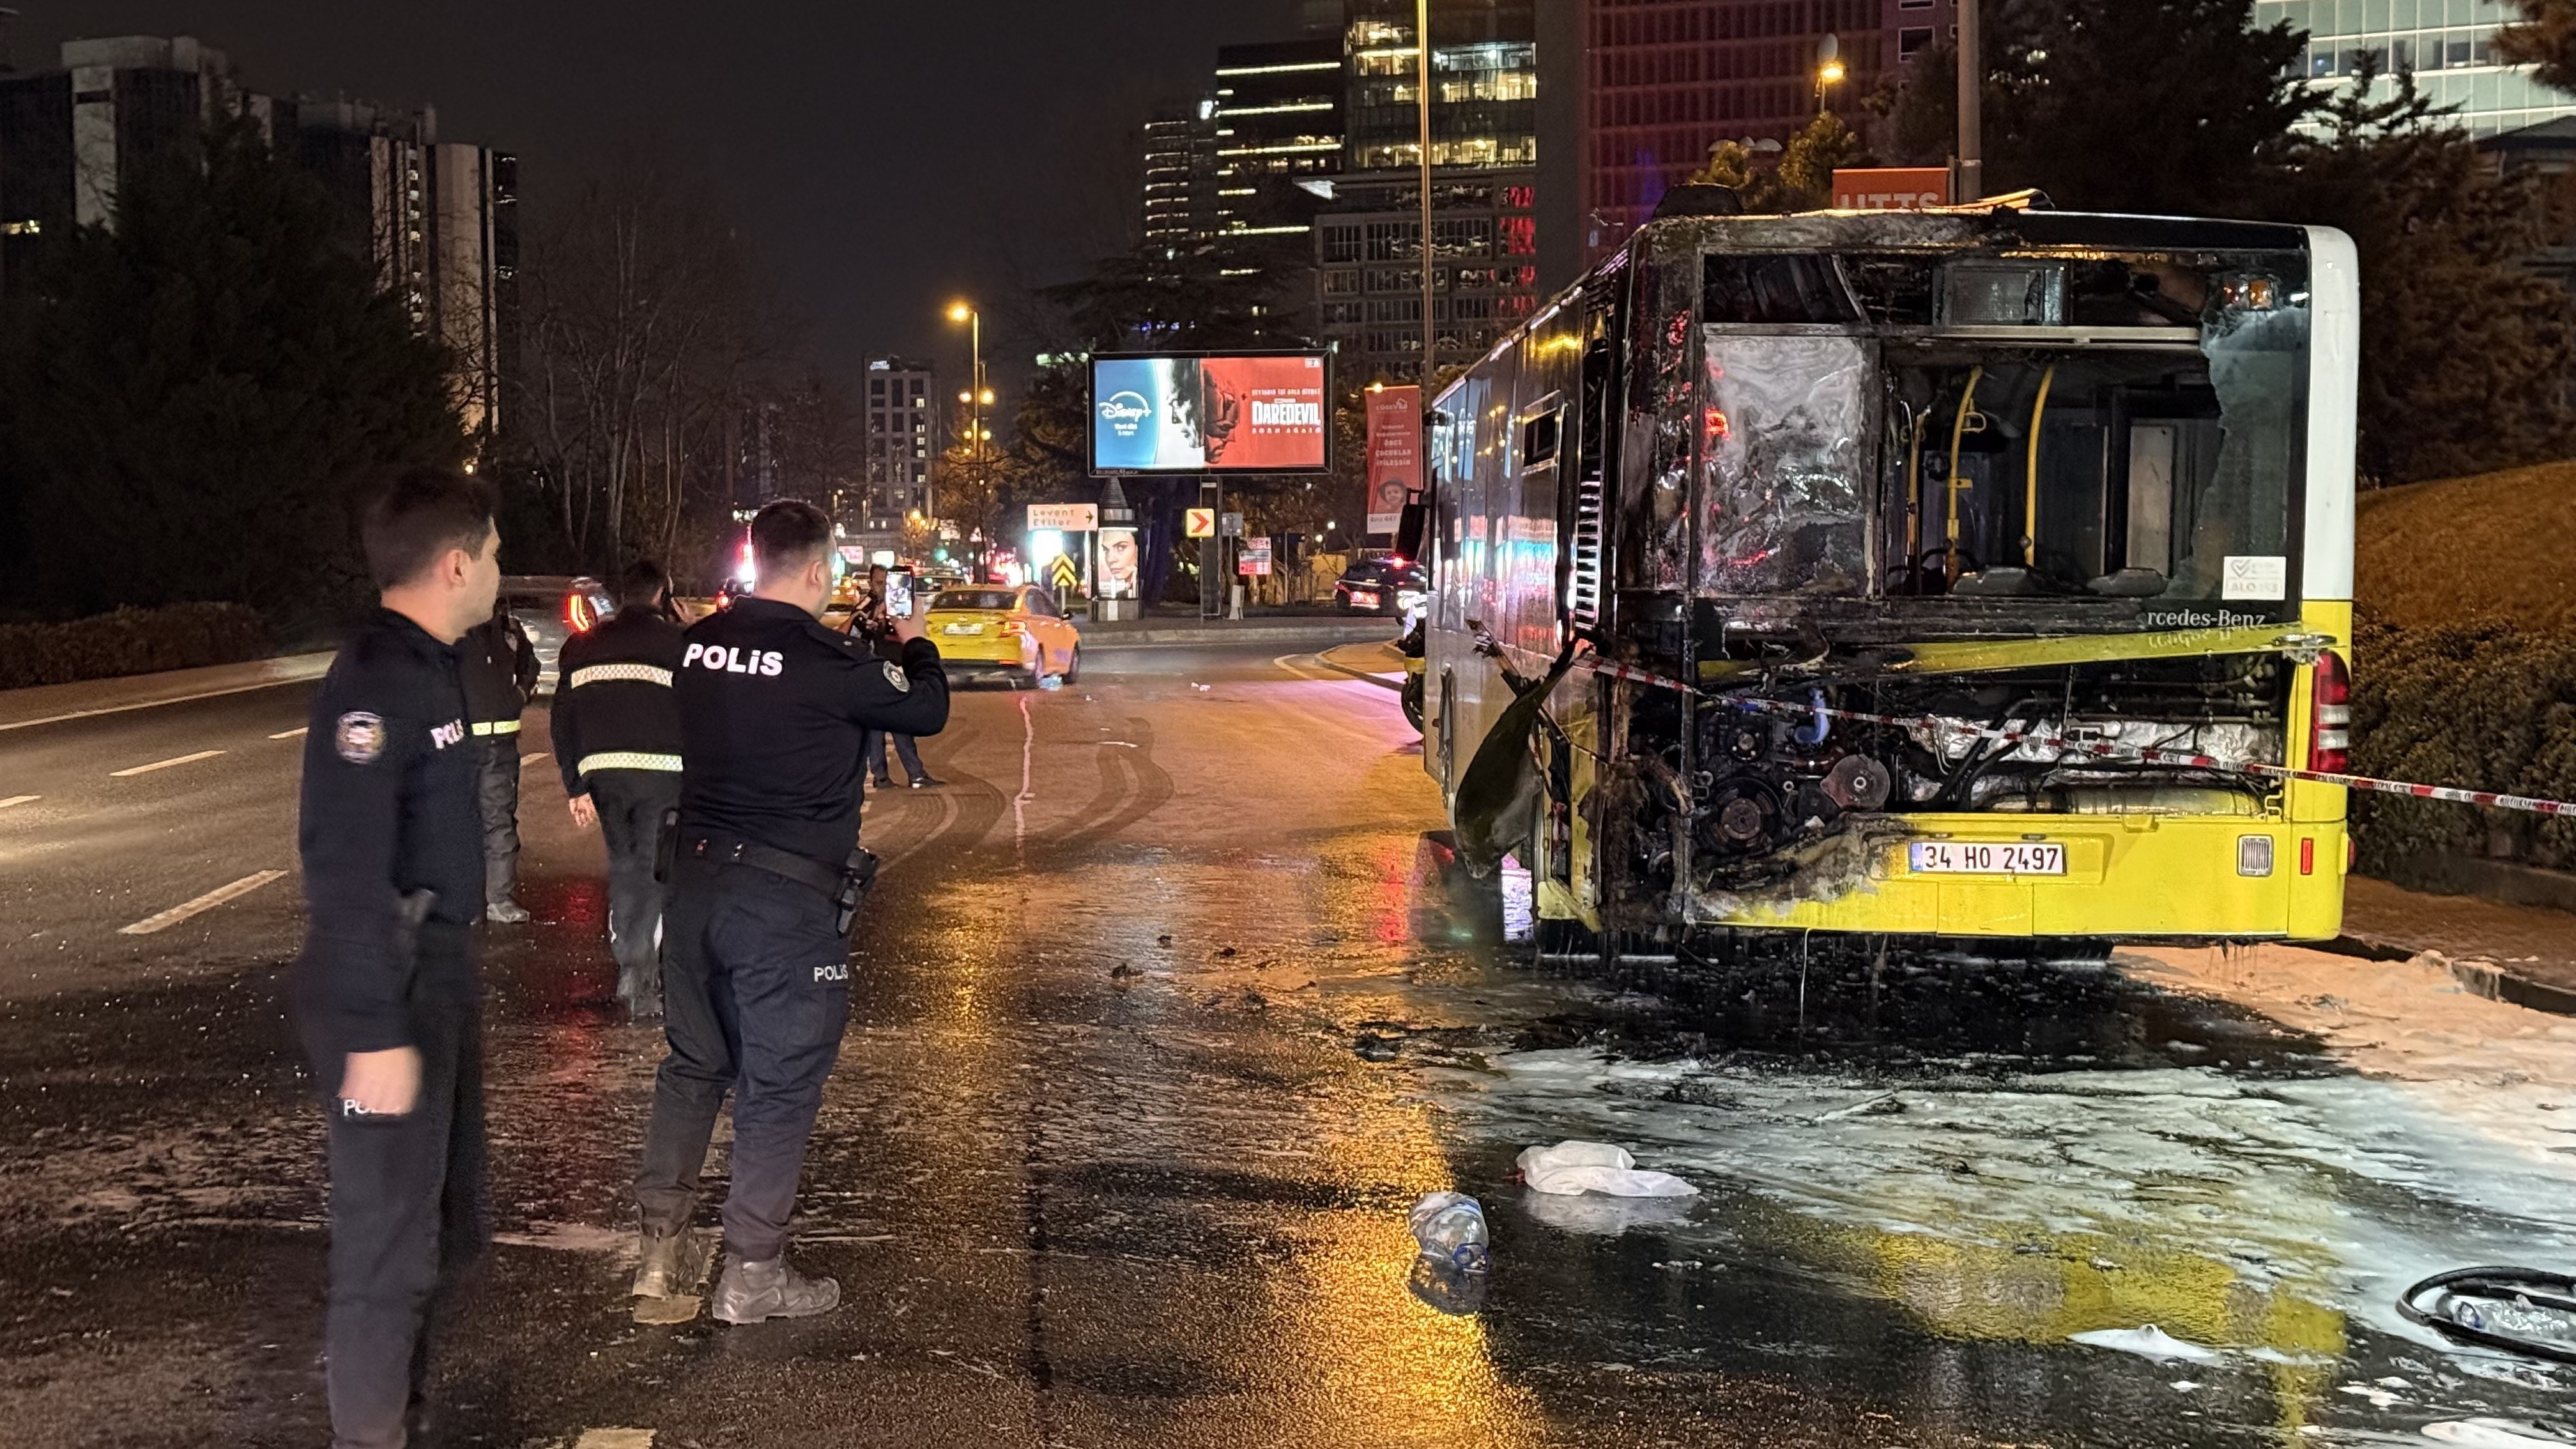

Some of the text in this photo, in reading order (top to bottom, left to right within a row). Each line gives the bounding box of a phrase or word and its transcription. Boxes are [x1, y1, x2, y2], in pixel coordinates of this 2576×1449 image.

[1099, 391, 1152, 422] Disney+
[1252, 401, 1321, 425] DAREDEVIL
[1033, 509, 1074, 517] Levent
[1033, 518, 1071, 526] Etiler
[2231, 582, 2256, 593] ALO
[1925, 846, 2058, 870] 34 HO 2497
